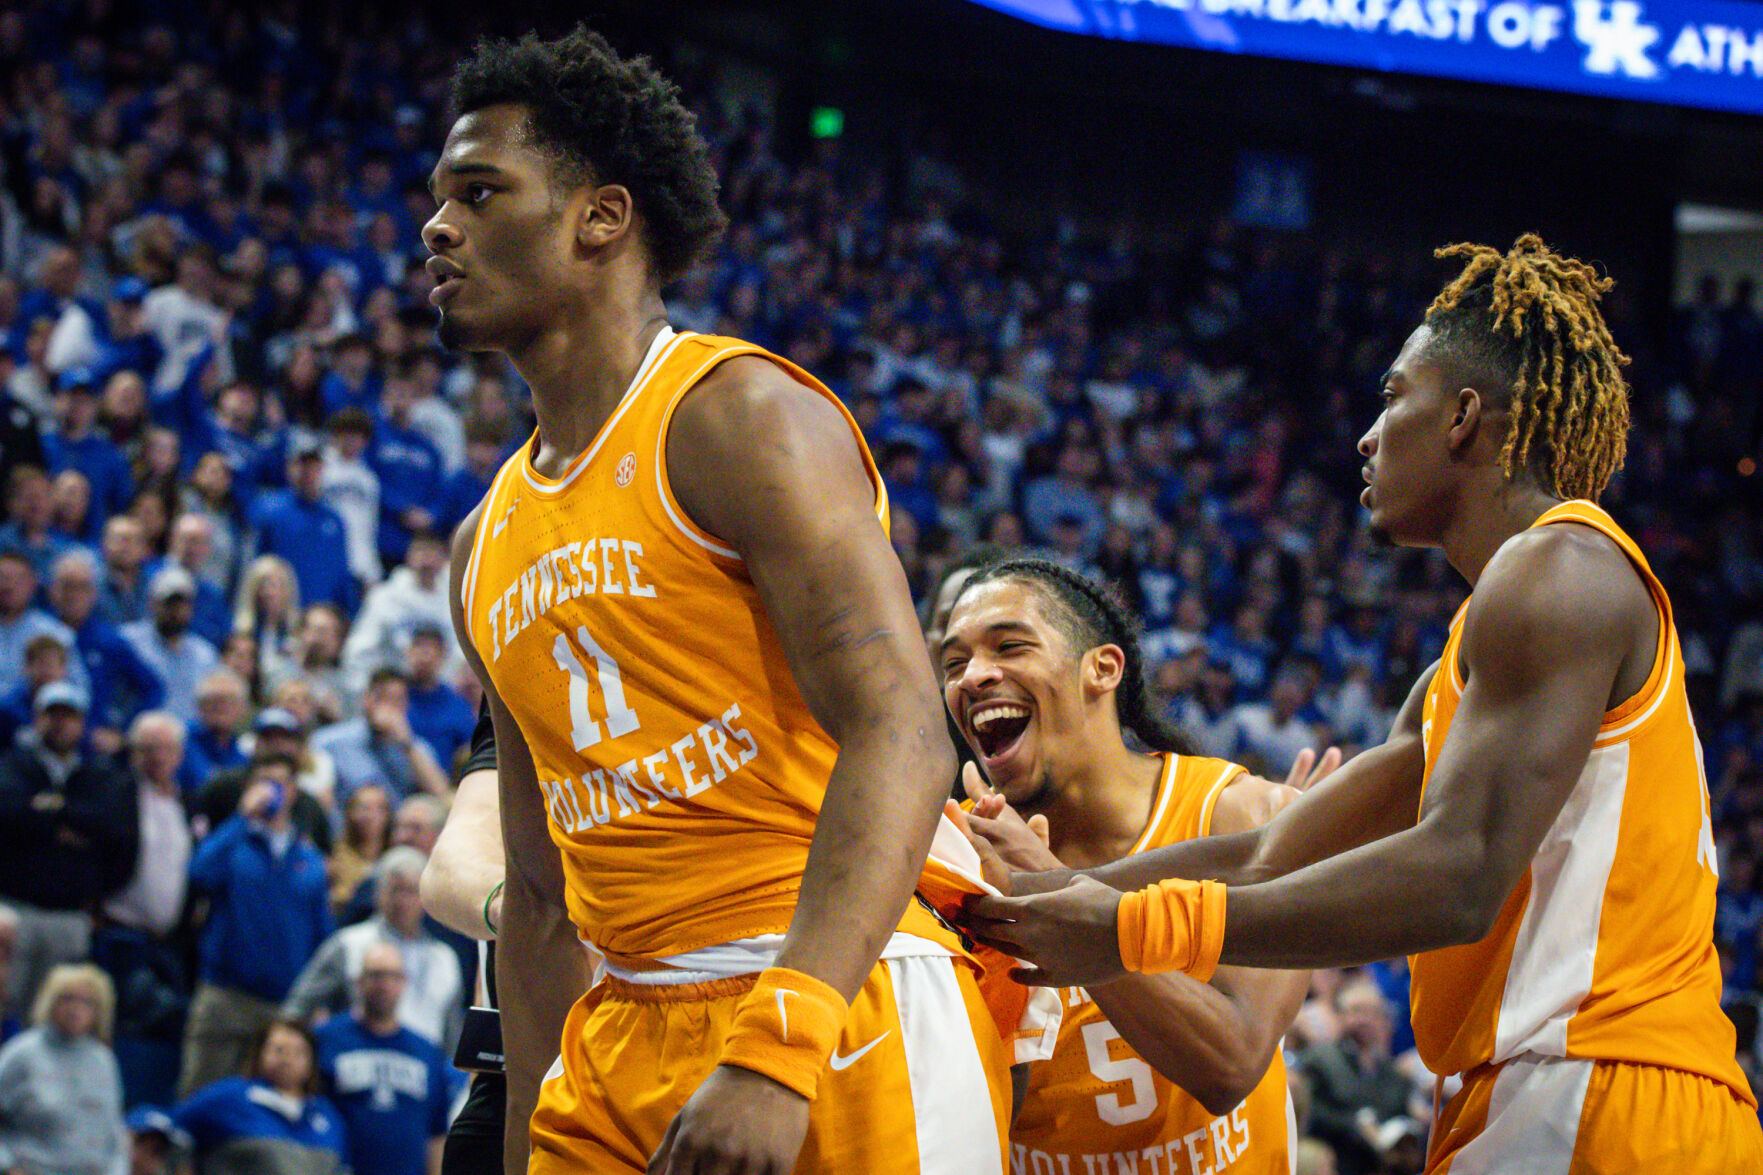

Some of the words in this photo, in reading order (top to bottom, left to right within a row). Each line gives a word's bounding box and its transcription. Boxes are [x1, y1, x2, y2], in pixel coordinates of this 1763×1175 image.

[1488, 3, 1563, 51] OF
[1668, 23, 1763, 78] ATH
[616, 454, 635, 485] SEC
[489, 537, 658, 662] TENNESSEE
[552, 624, 641, 753] 11
[1081, 1020, 1158, 1126] 5
